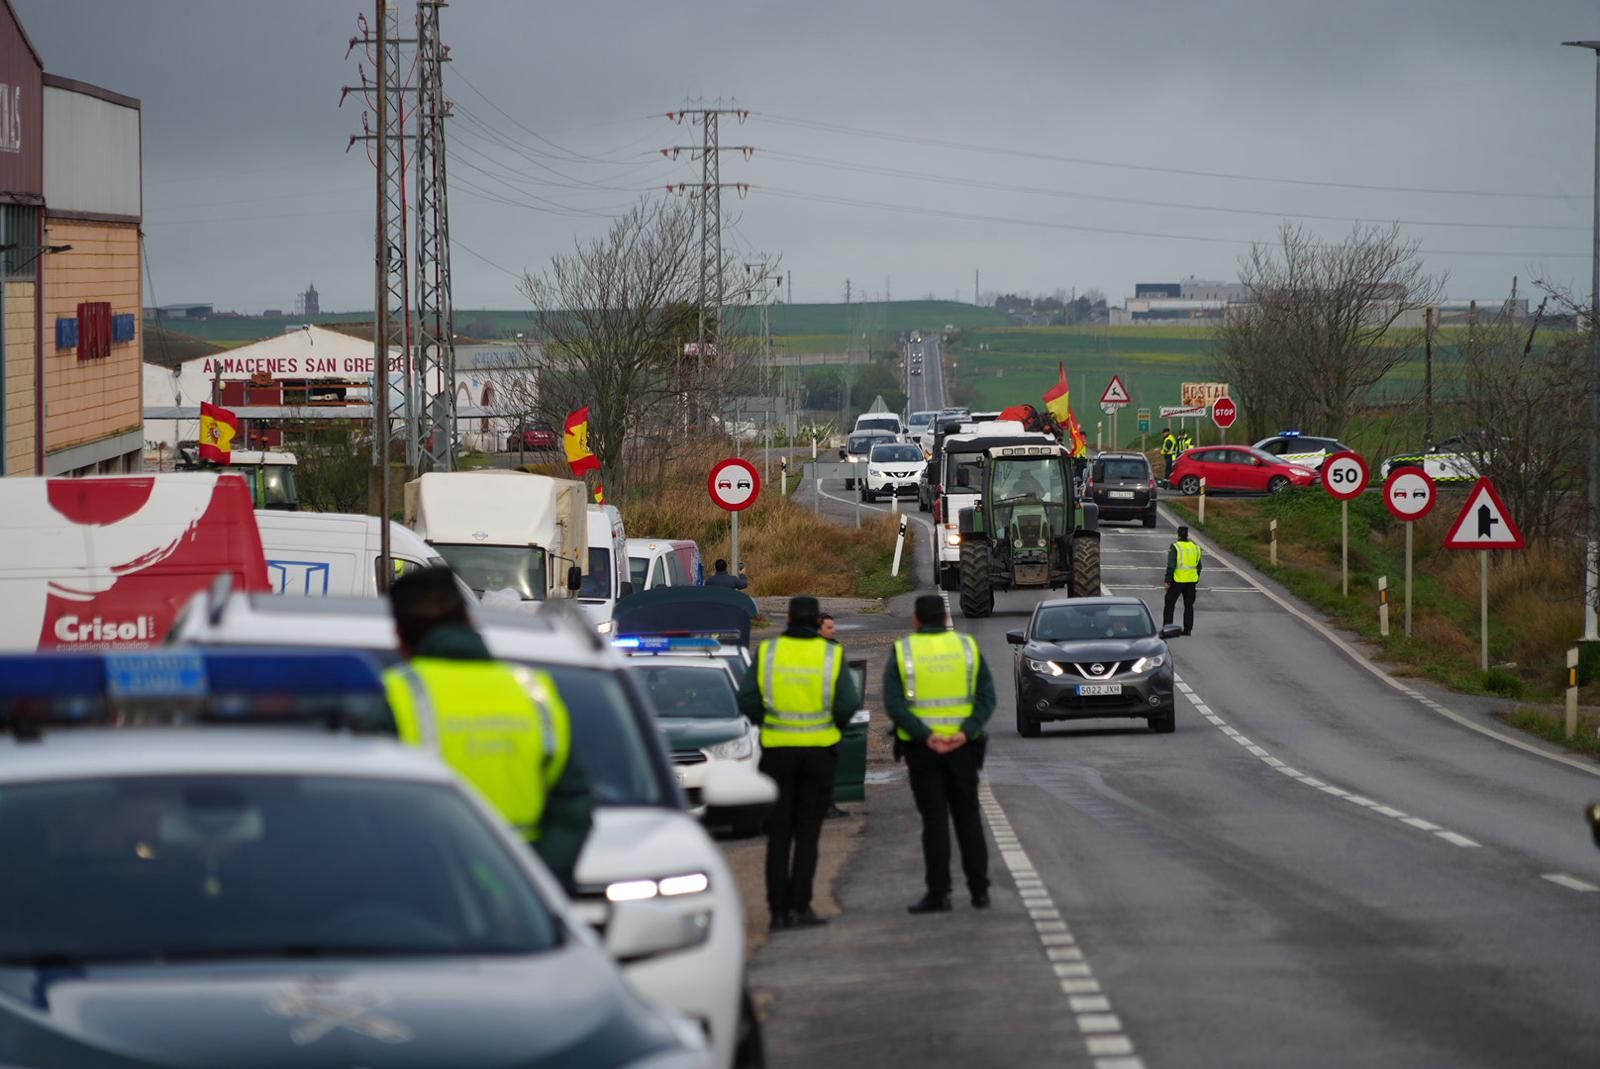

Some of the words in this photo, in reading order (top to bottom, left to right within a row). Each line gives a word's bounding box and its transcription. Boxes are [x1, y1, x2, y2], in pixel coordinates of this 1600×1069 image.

[305, 358, 336, 373] SAN
[1333, 468, 1358, 484] 50
[54, 615, 147, 642] Crisol
[1104, 686, 1120, 694] JXH
